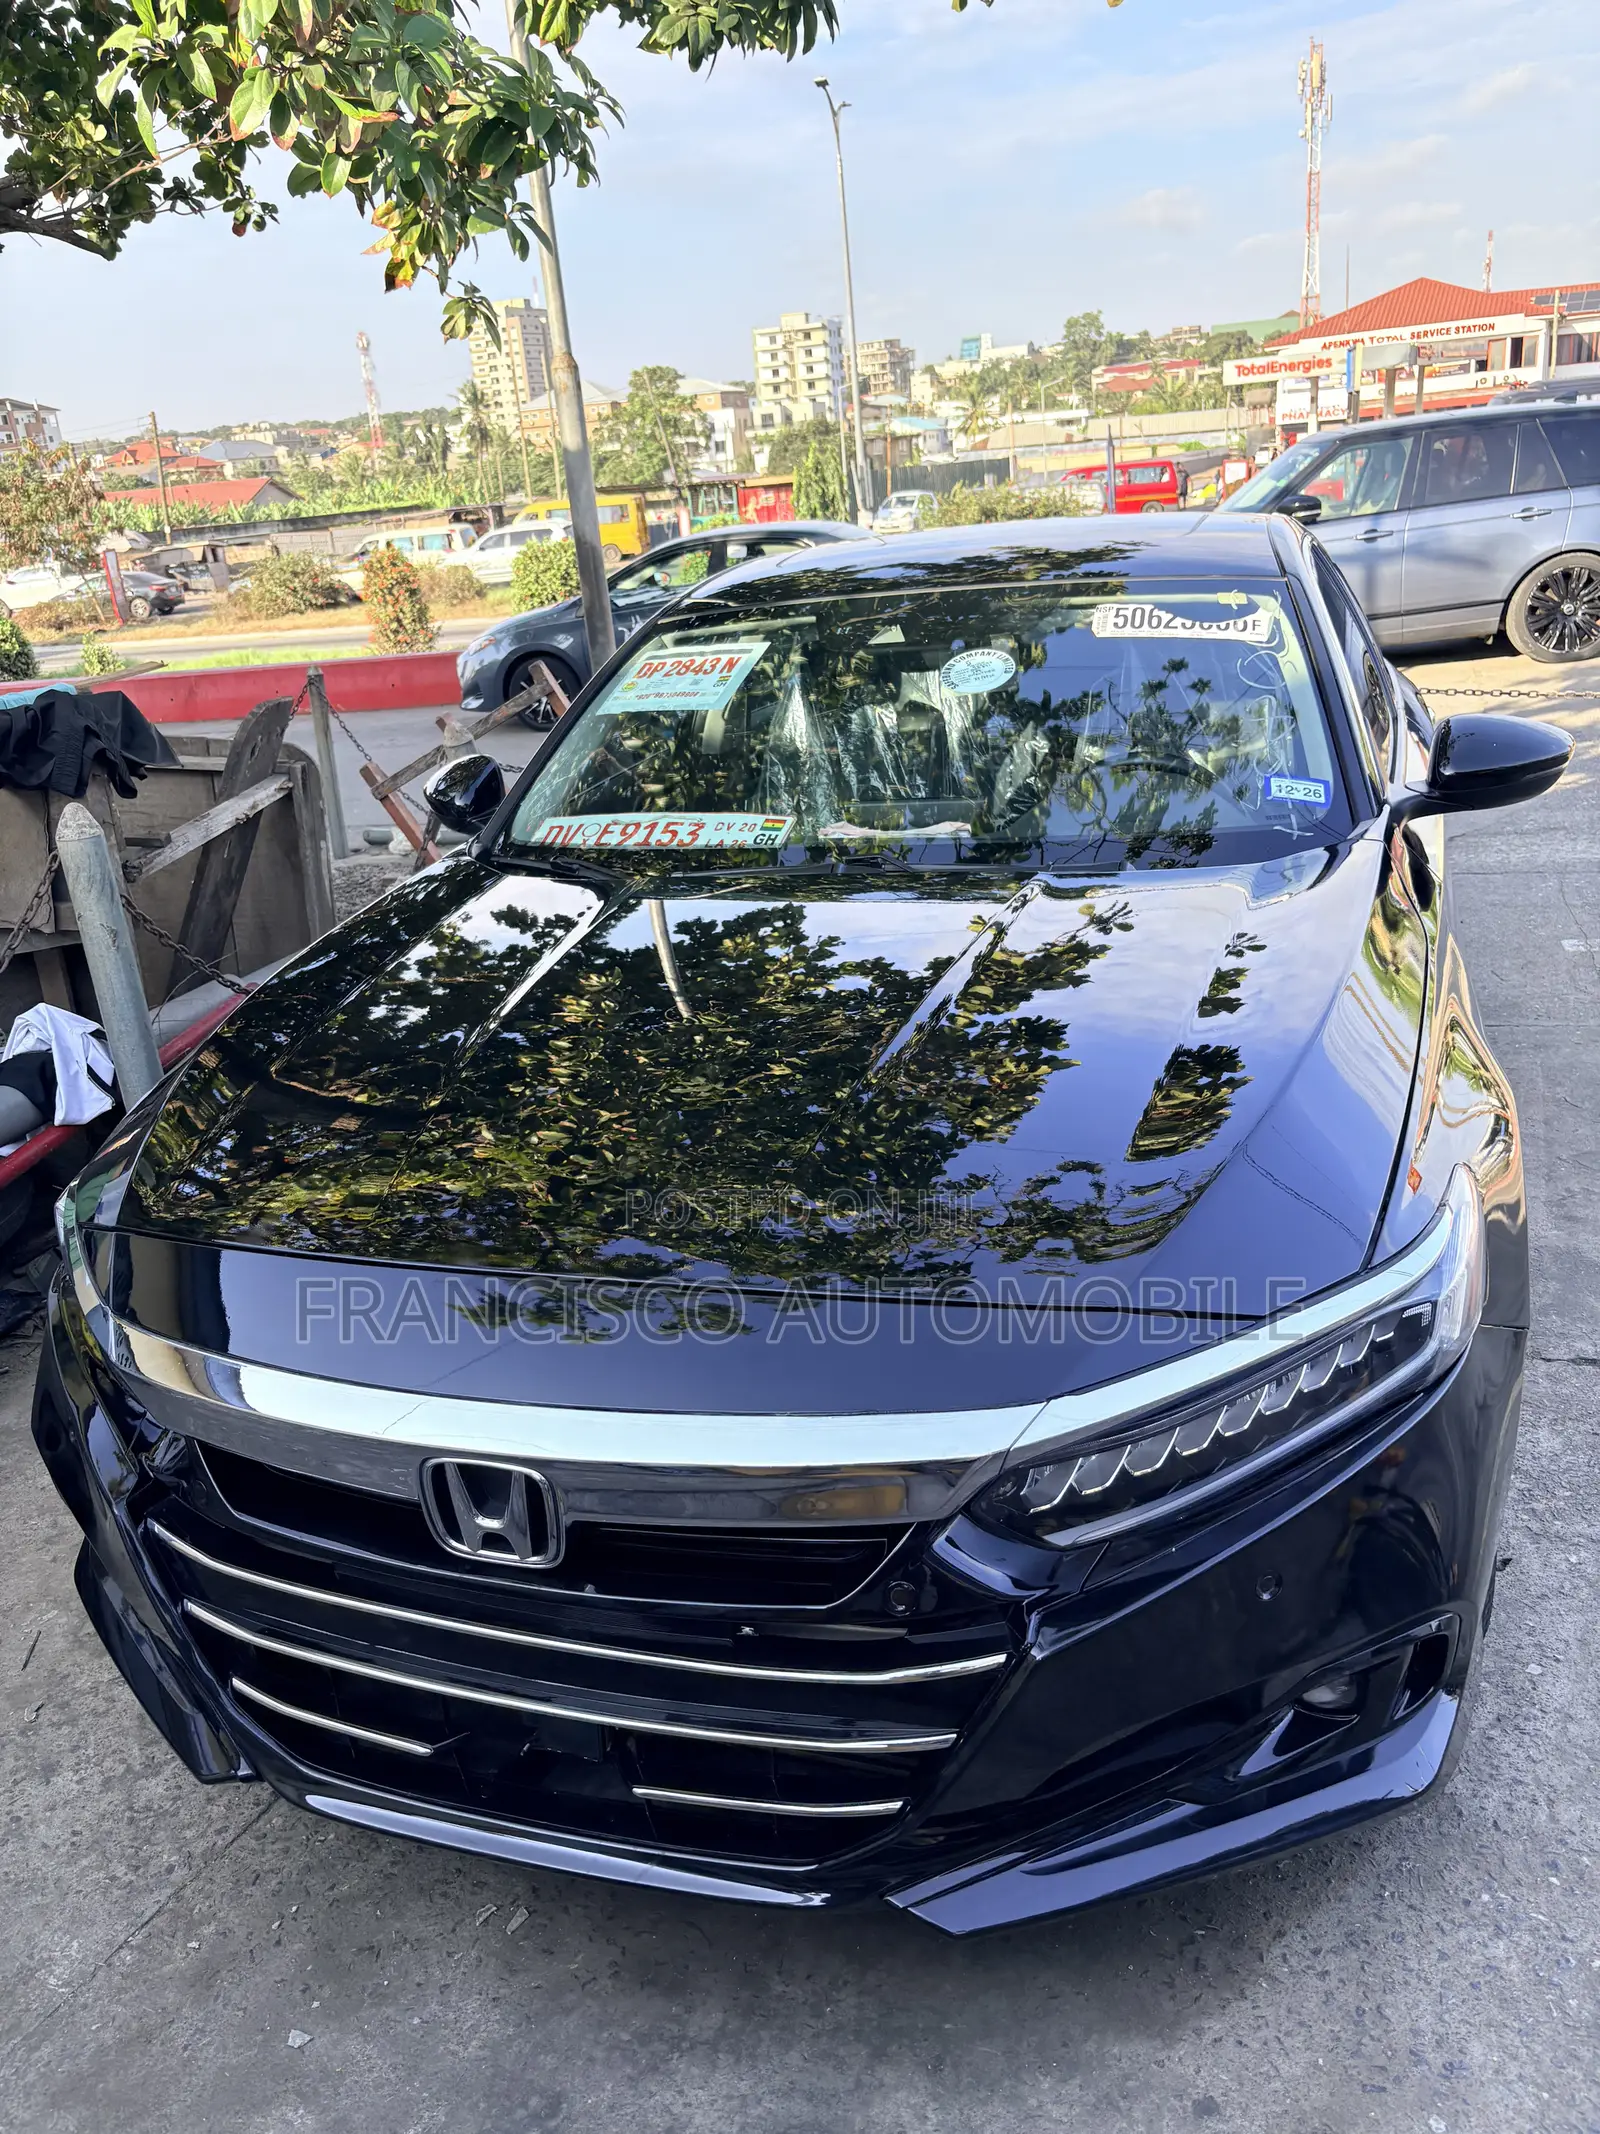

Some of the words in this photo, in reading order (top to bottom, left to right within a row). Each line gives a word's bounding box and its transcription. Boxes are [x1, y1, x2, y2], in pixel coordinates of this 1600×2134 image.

[1410, 327, 1452, 341] SERVICE
[1454, 322, 1496, 335] STATION
[1235, 355, 1332, 377] TotalEnergies
[1281, 407, 1346, 422] PHAACY
[632, 661, 667, 679] DP
[663, 656, 722, 678] 2843
[719, 656, 742, 674] N
[954, 651, 997, 664] COMPANY
[997, 653, 1015, 674] LIMITED
[753, 833, 779, 846] GH
